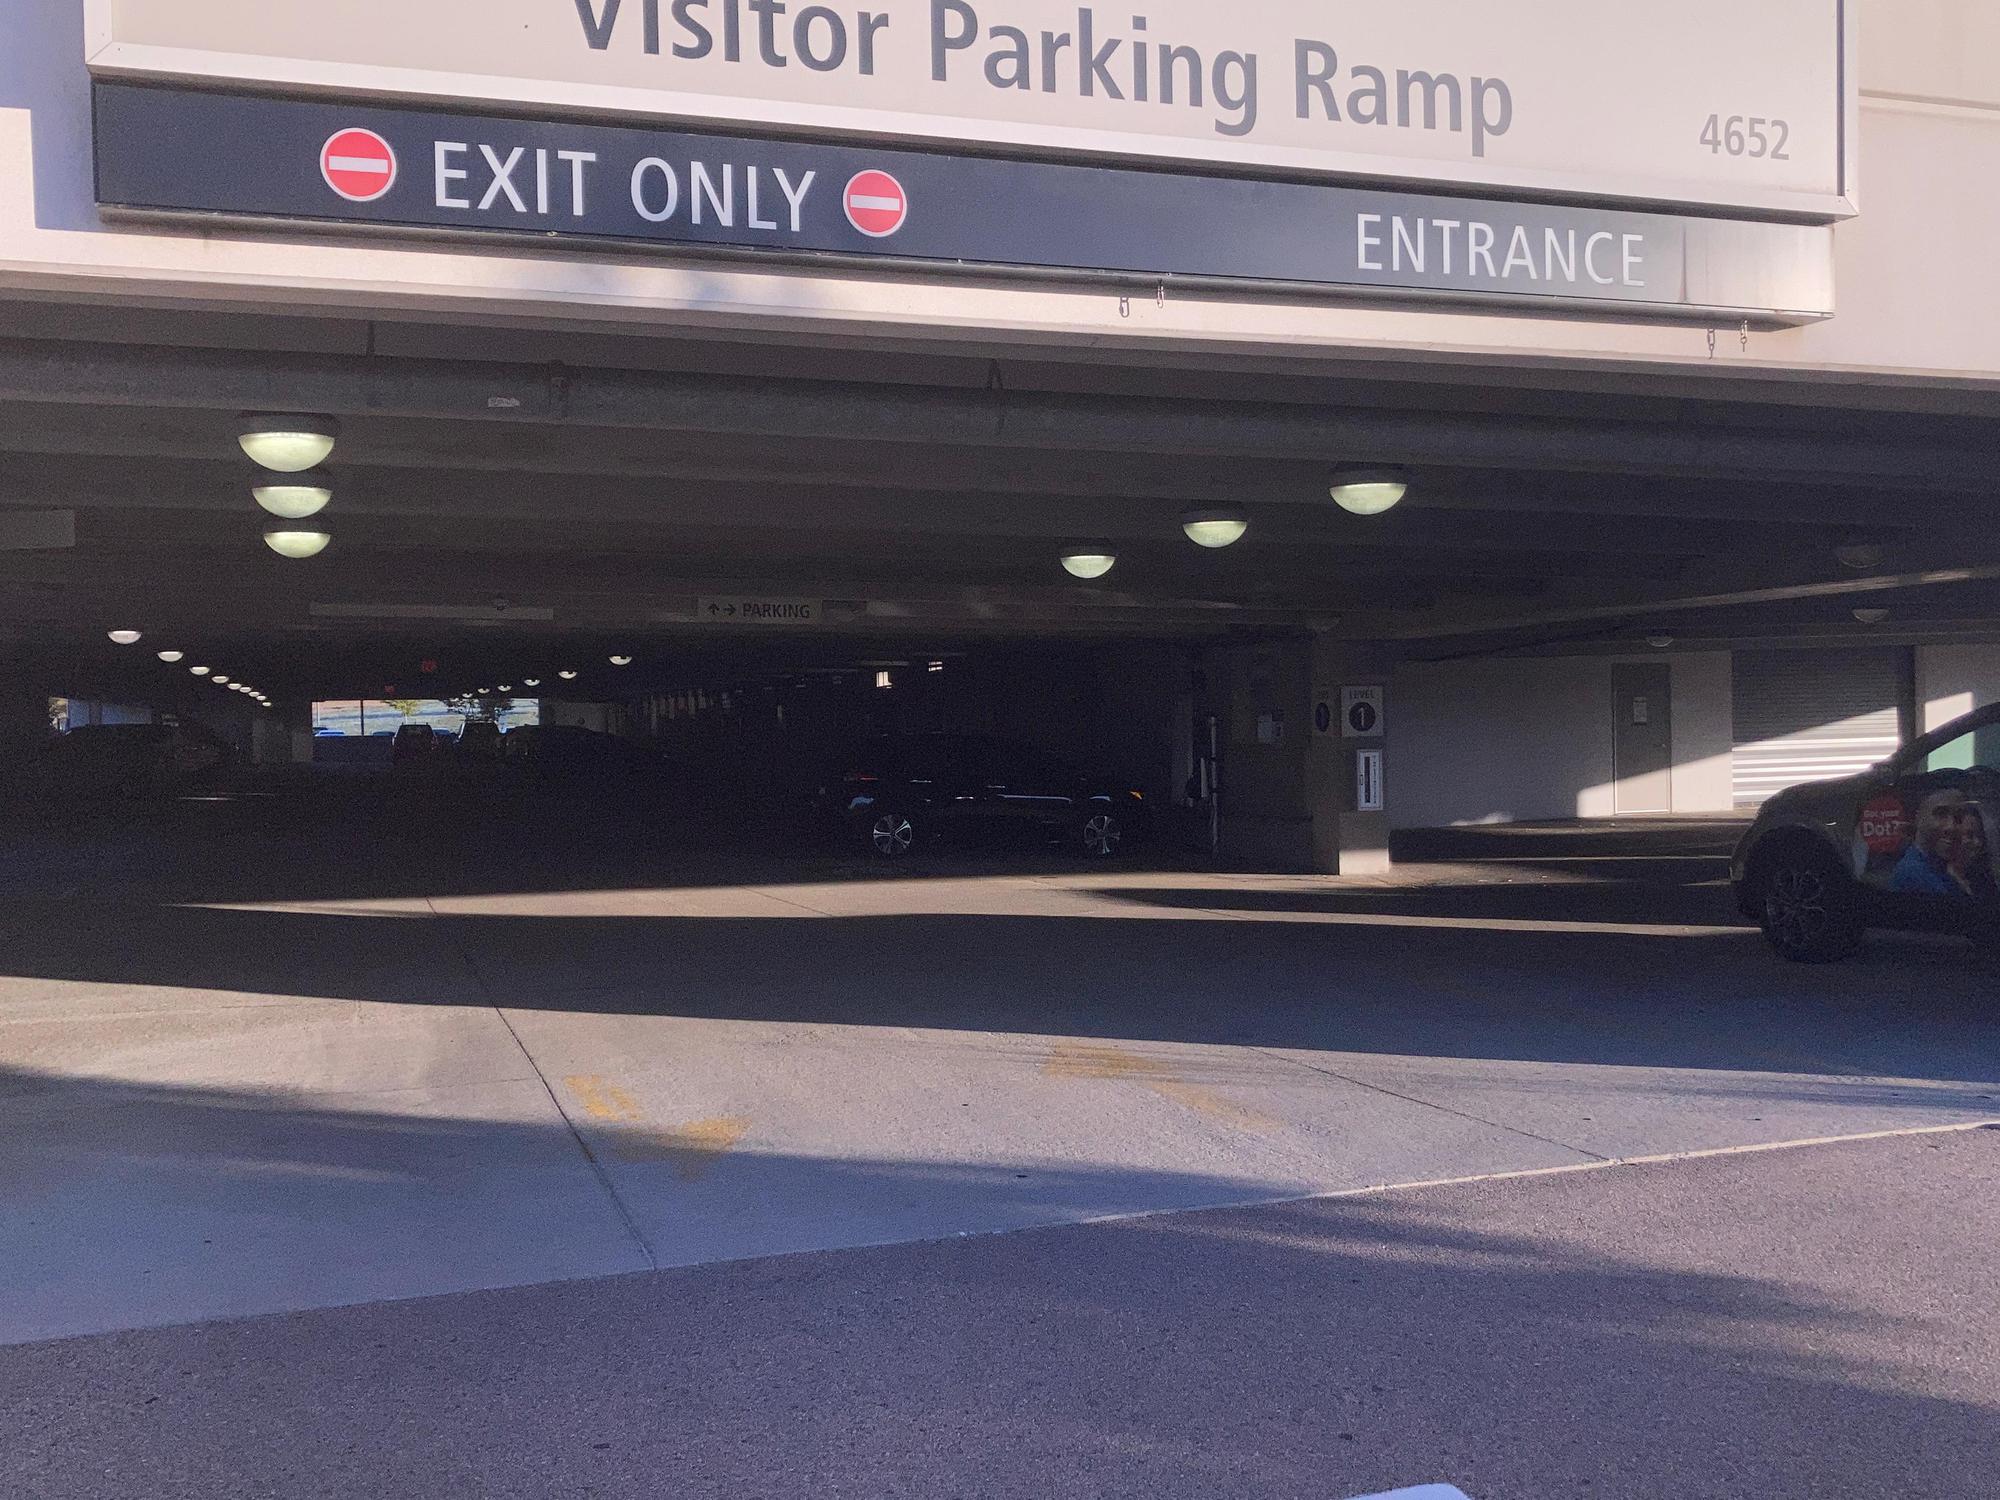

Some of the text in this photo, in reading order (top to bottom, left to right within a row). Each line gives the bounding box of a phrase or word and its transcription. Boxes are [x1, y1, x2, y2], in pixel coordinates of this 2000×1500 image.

[574, 0, 1512, 158] Visitor Parking Ramp
[1699, 114, 1790, 161] 4652
[434, 140, 818, 233] EXIT ONLY
[1356, 213, 1646, 288] ENTRANCE
[742, 603, 811, 618] PARKING
[1350, 687, 1375, 699] LEVEL
